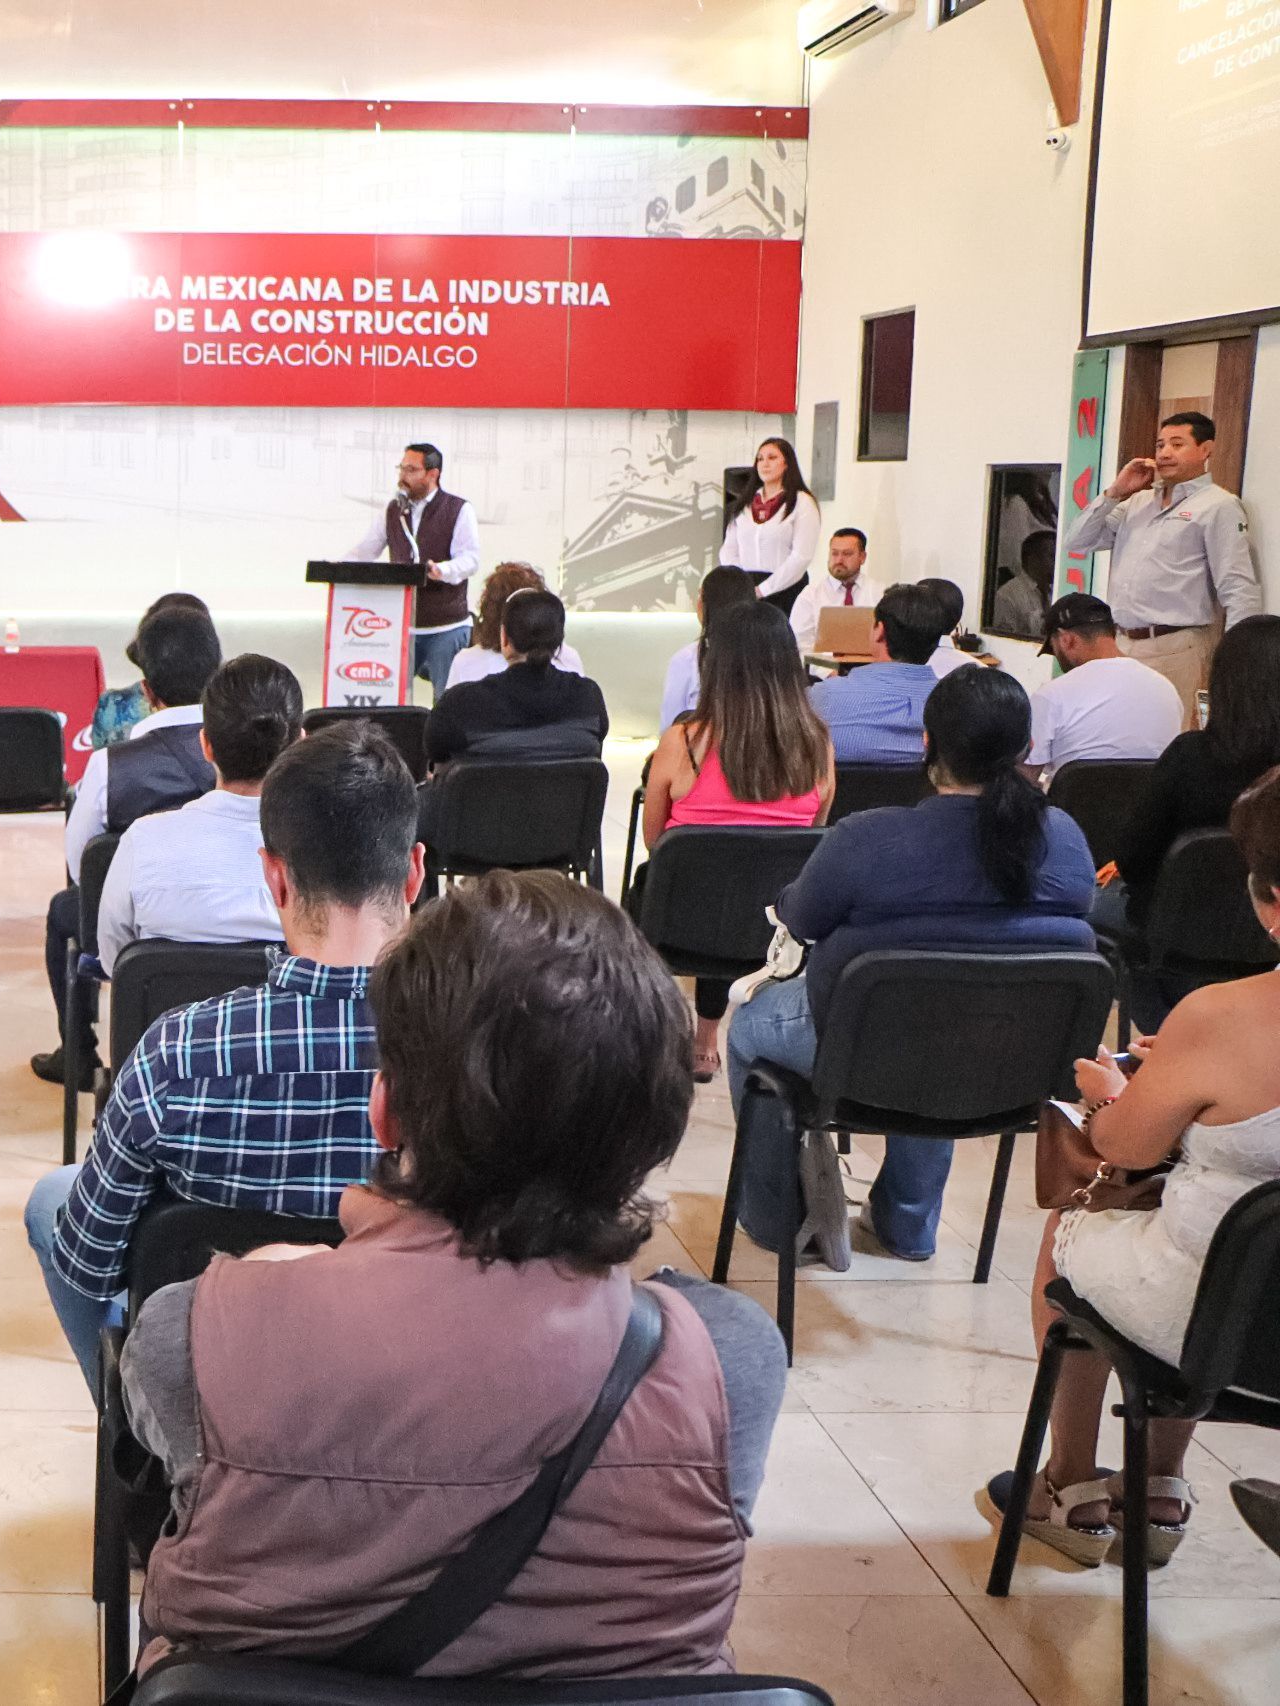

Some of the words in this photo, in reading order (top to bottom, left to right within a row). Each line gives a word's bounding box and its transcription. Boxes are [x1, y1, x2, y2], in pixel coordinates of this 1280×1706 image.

[181, 276, 344, 301] MEXICANA
[353, 278, 393, 302] DE
[402, 279, 439, 303] LA
[449, 280, 611, 306] INDUSTRIA
[154, 307, 195, 332] DE
[204, 308, 242, 332] LA
[250, 306, 489, 335] CONSTRUCCIÓN
[183, 339, 352, 366] DELEGACIÓN
[360, 344, 478, 368] HIDALGO
[349, 663, 386, 679] cmic
